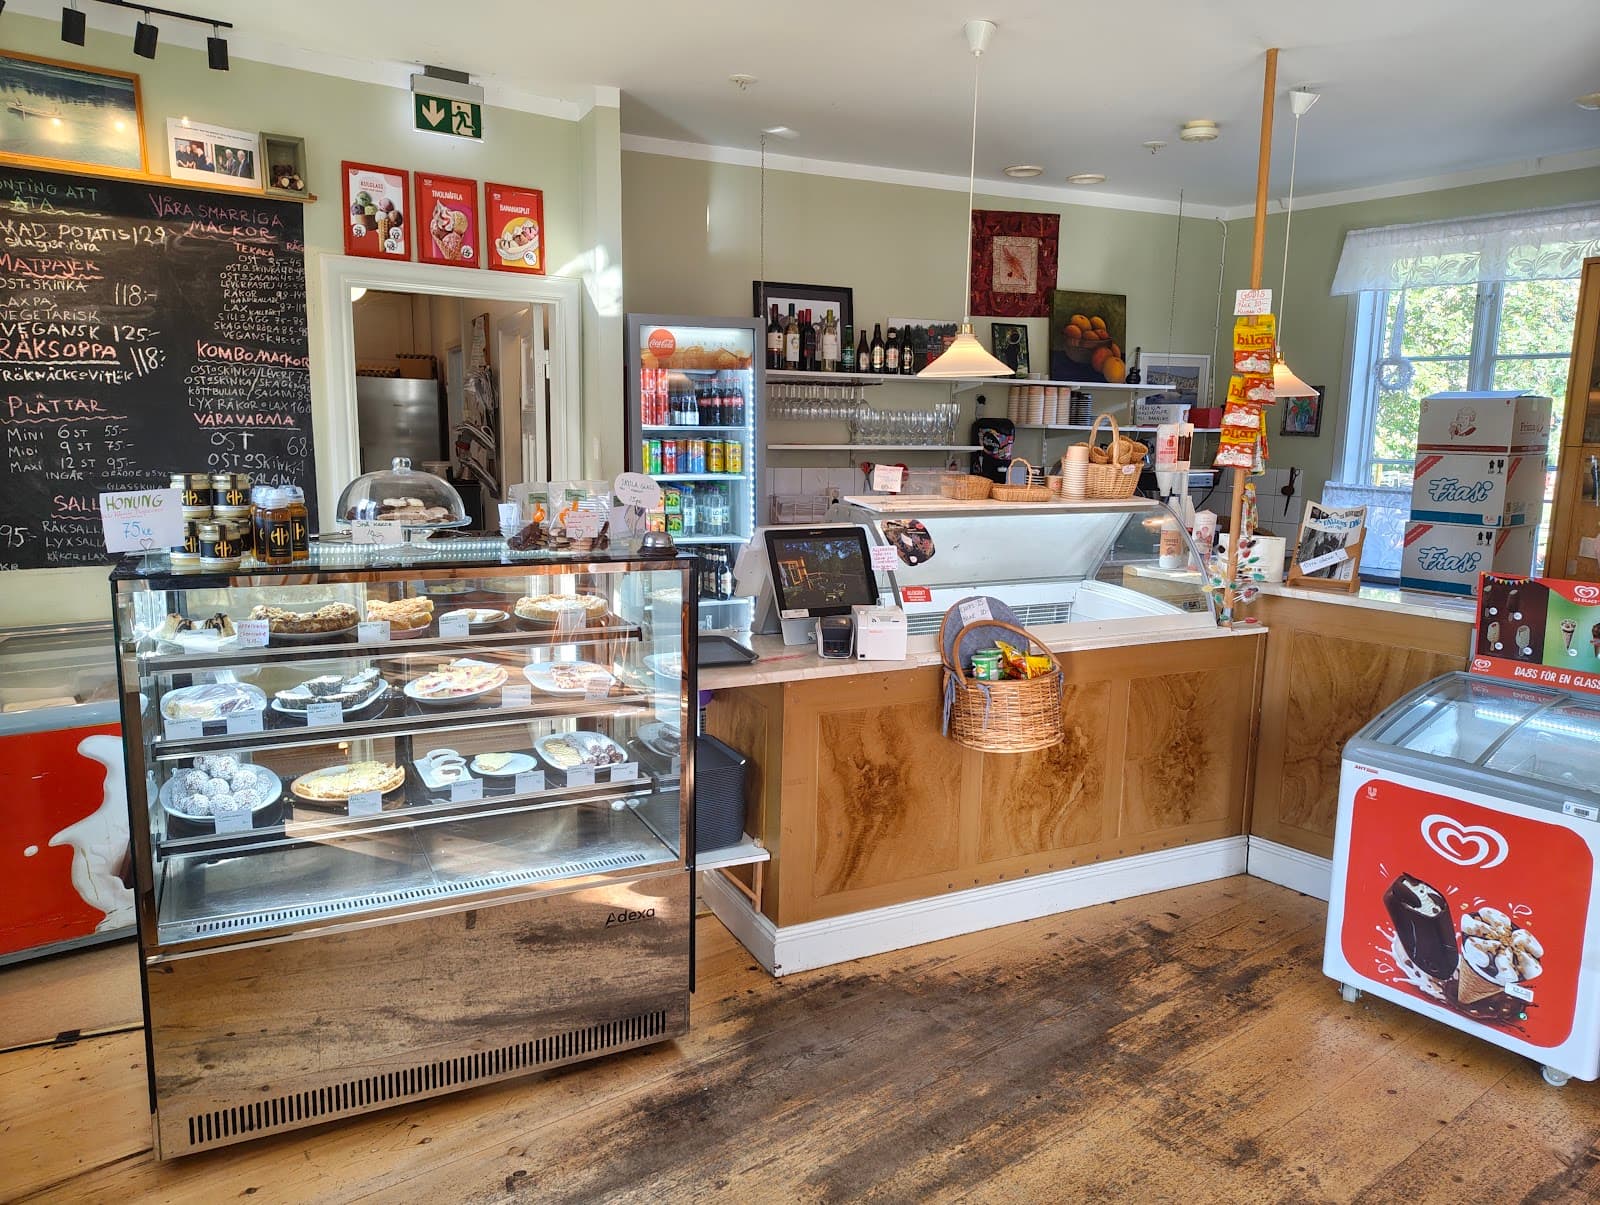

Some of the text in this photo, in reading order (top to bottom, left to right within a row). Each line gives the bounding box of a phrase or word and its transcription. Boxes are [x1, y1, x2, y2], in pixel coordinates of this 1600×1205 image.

[11, 191, 55, 210] ÄTA
[66, 186, 98, 201] ATT
[149, 194, 284, 228] VÅRA SMARRIGA
[58, 224, 131, 242] POTATIS
[189, 220, 278, 239] MACKOR
[226, 263, 241, 271] OST
[239, 255, 262, 265] OST
[220, 272, 241, 280] OST
[0, 278, 25, 291] OST
[32, 278, 89, 292] SKINKA
[0, 309, 101, 322] VEGETARISK
[223, 303, 249, 313] LAX
[1, 322, 100, 341] VEGANSK
[222, 331, 276, 344] VEGANSK
[0, 333, 118, 361] RÄKSOPPA
[1236, 333, 1273, 346] bilar
[190, 365, 212, 376] OST
[183, 376, 207, 385] OST
[8, 391, 108, 418] PLÄTTAR
[193, 411, 296, 427] VÅRA VARMA
[57, 424, 71, 439] 6
[73, 428, 89, 439] ST
[59, 440, 71, 455] 9
[77, 442, 93, 452] ST
[210, 431, 255, 452] OST
[60, 456, 75, 470] 12
[81, 458, 97, 468] ST
[207, 452, 241, 468] OST
[1428, 477, 1494, 504] Frasi
[105, 494, 163, 512] HONUNG
[42, 519, 105, 534] RÄKSALL
[1417, 546, 1482, 574] Frasi
[1558, 673, 1572, 685] EN
[605, 907, 656, 928] Adexa
